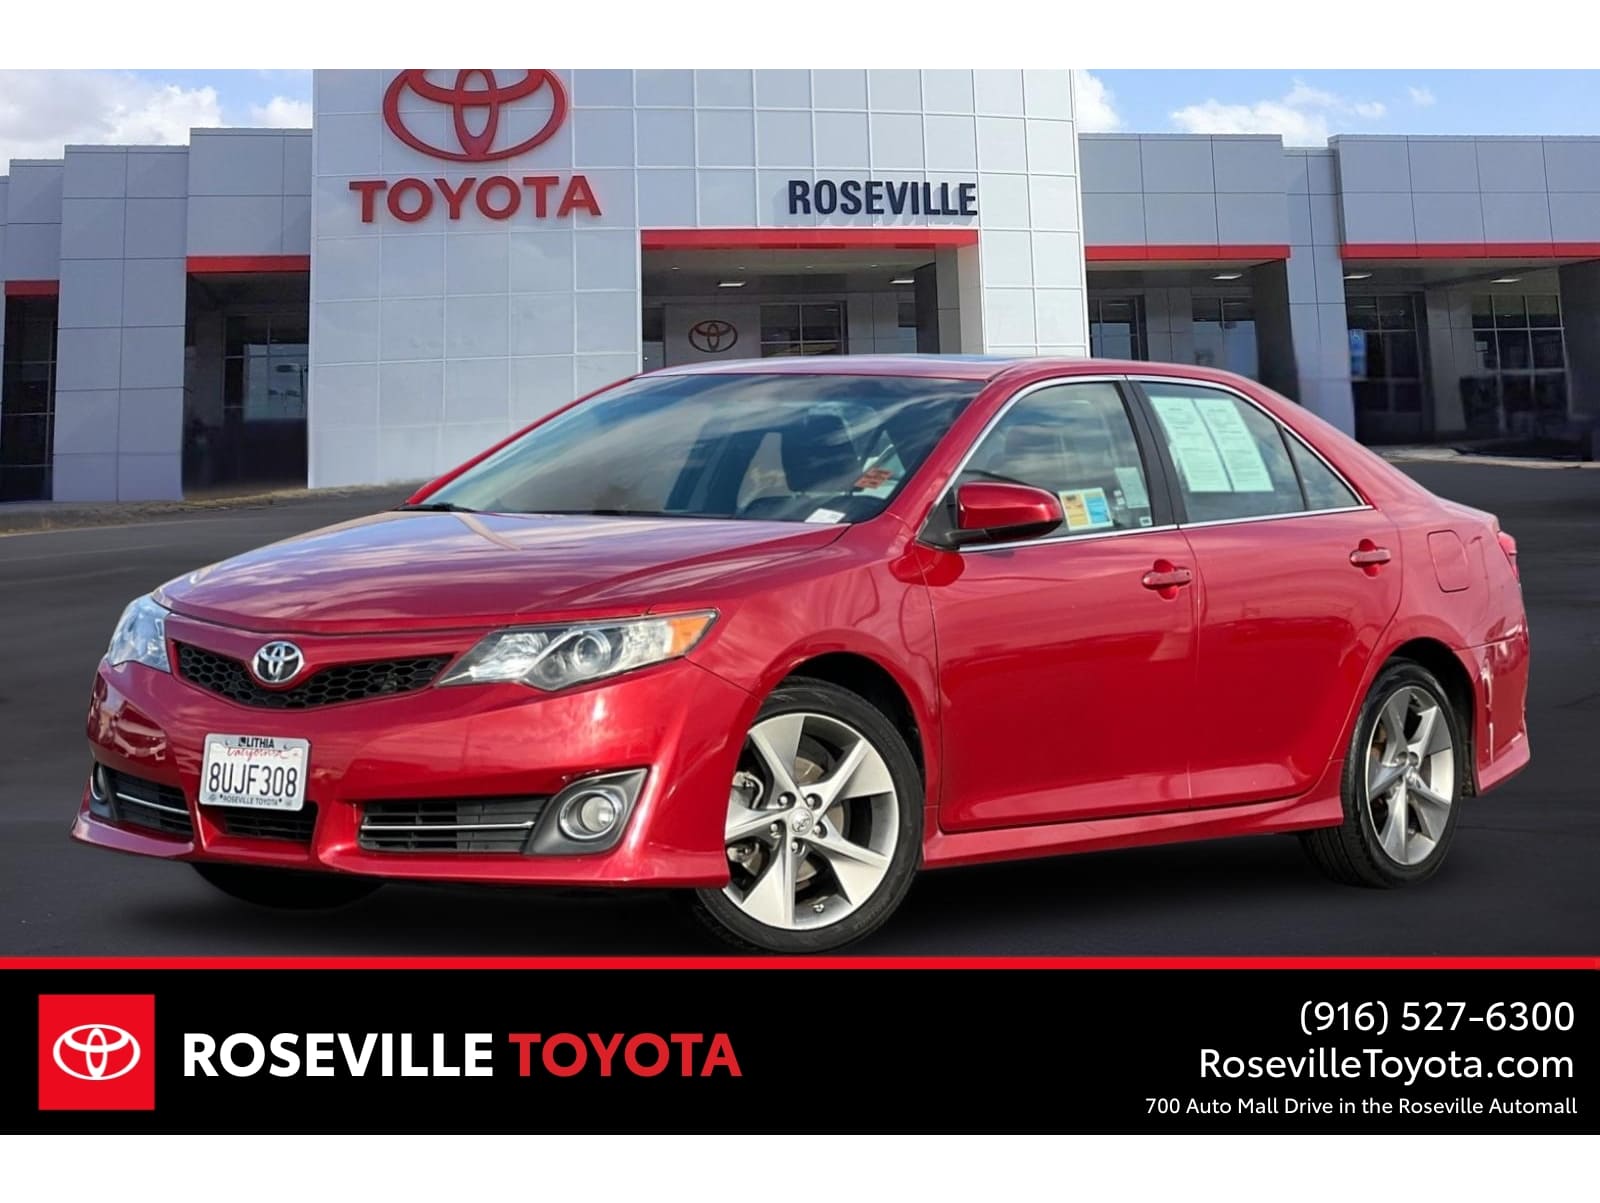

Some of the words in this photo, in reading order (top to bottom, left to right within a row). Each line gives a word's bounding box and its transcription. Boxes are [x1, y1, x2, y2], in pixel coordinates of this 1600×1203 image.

[349, 175, 602, 223] TOYOTA
[788, 179, 979, 217] ROSEVILLE
[246, 737, 275, 748] LITHIA
[209, 762, 297, 797] 8UJF308
